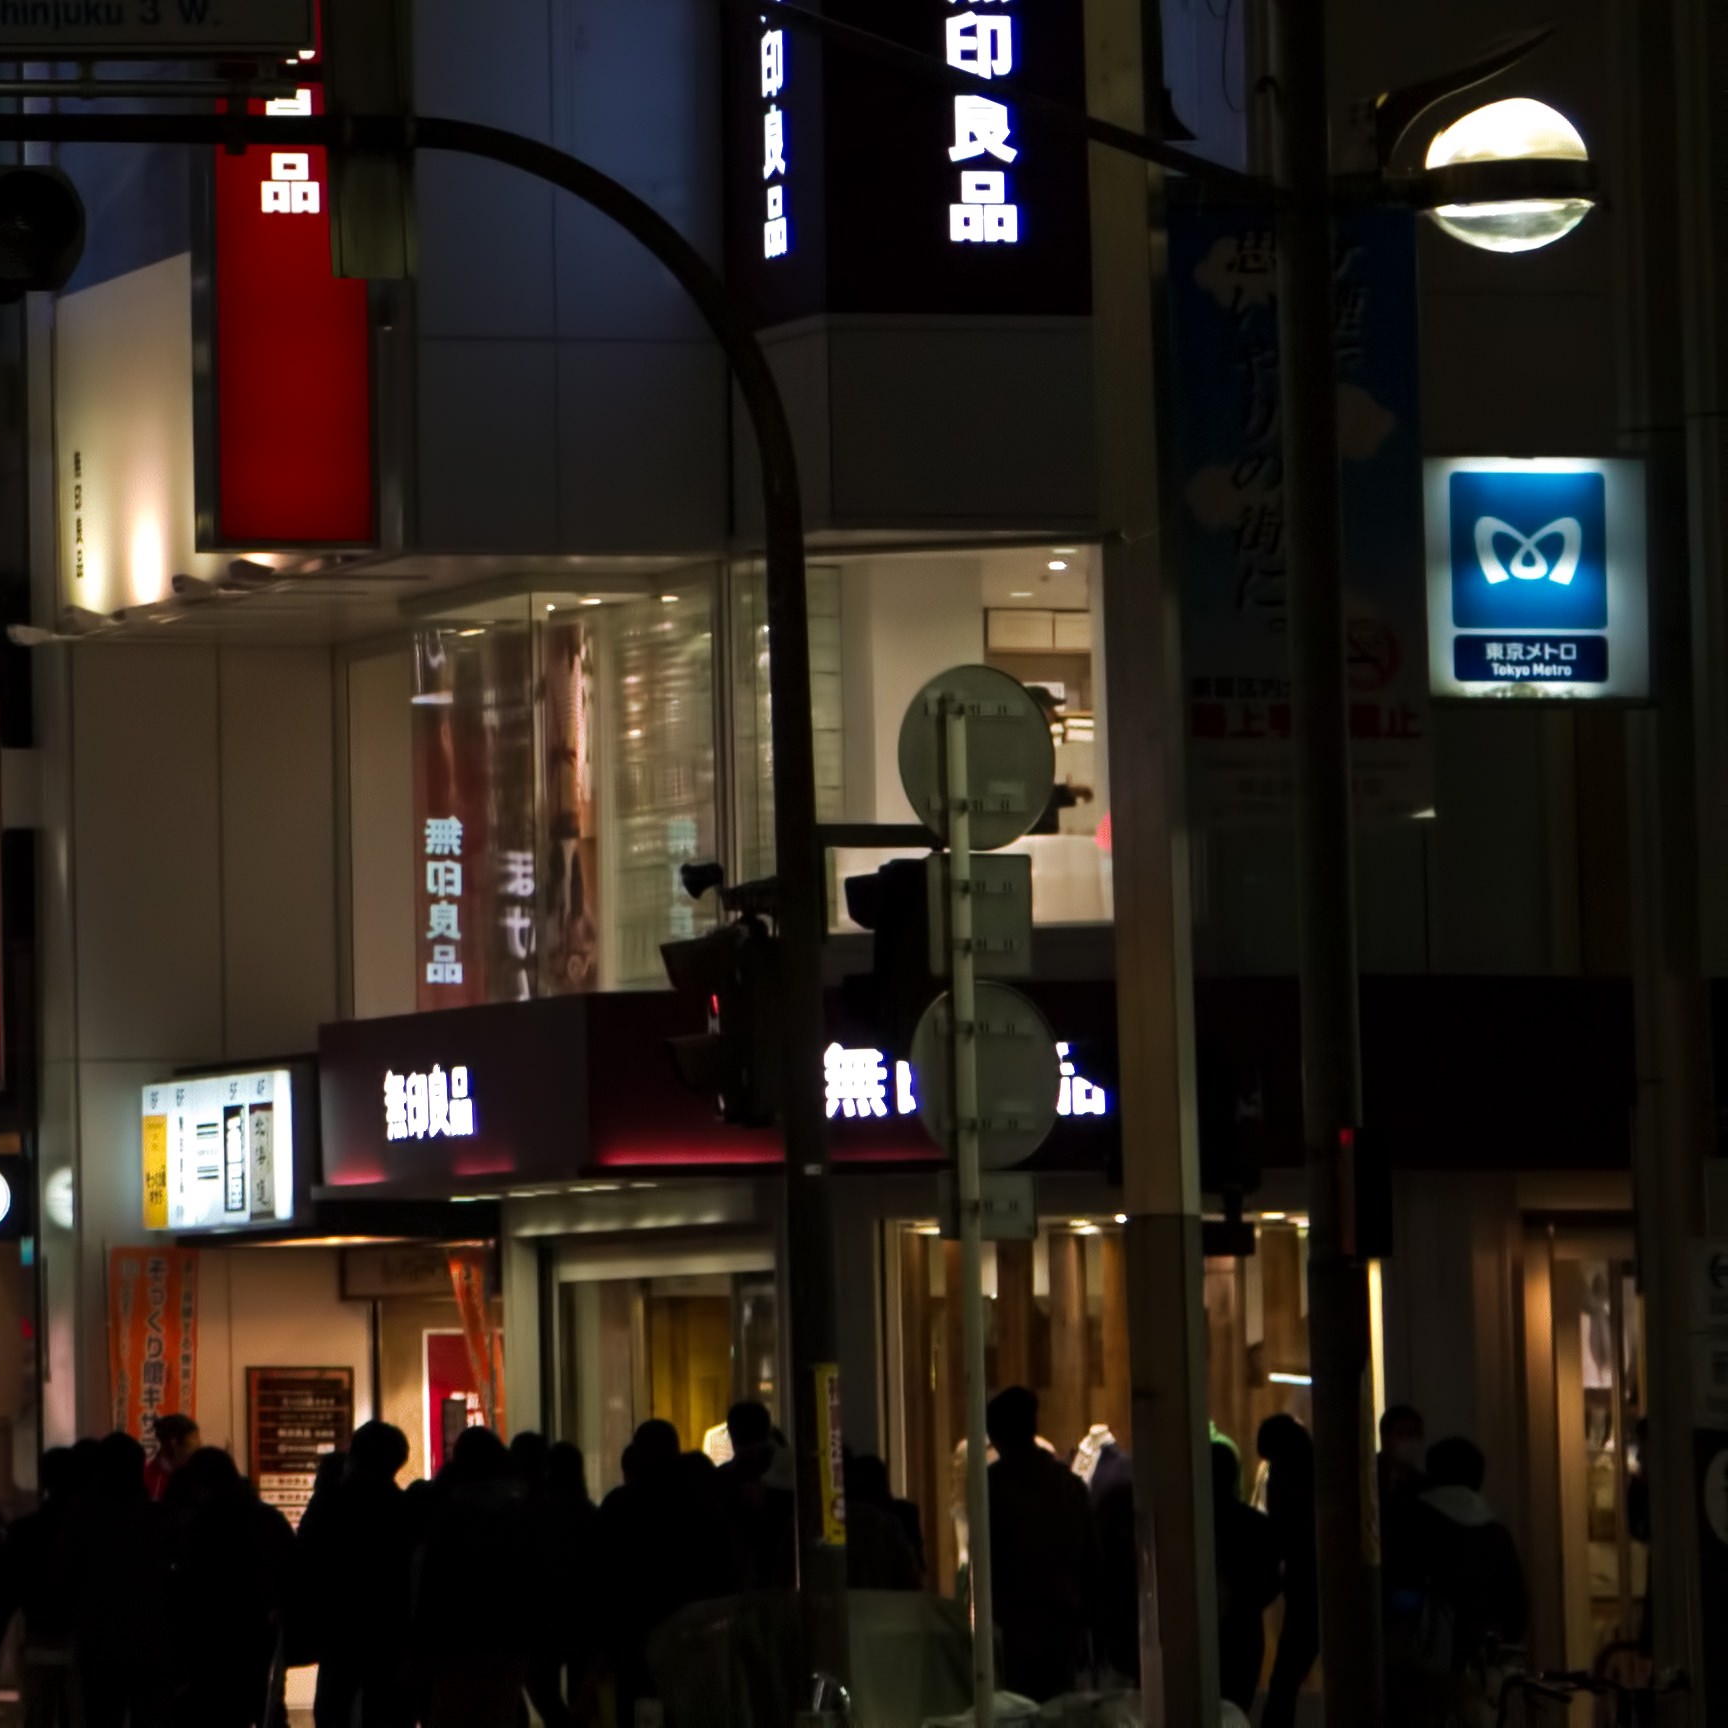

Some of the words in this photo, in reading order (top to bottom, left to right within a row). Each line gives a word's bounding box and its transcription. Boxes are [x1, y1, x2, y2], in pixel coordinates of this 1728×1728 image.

[1485, 642, 1577, 662] 東京メトロ
[1491, 662, 1530, 678] Tokyo
[1533, 662, 1573, 677] Metro
[384, 1065, 475, 1142] 無印良品
